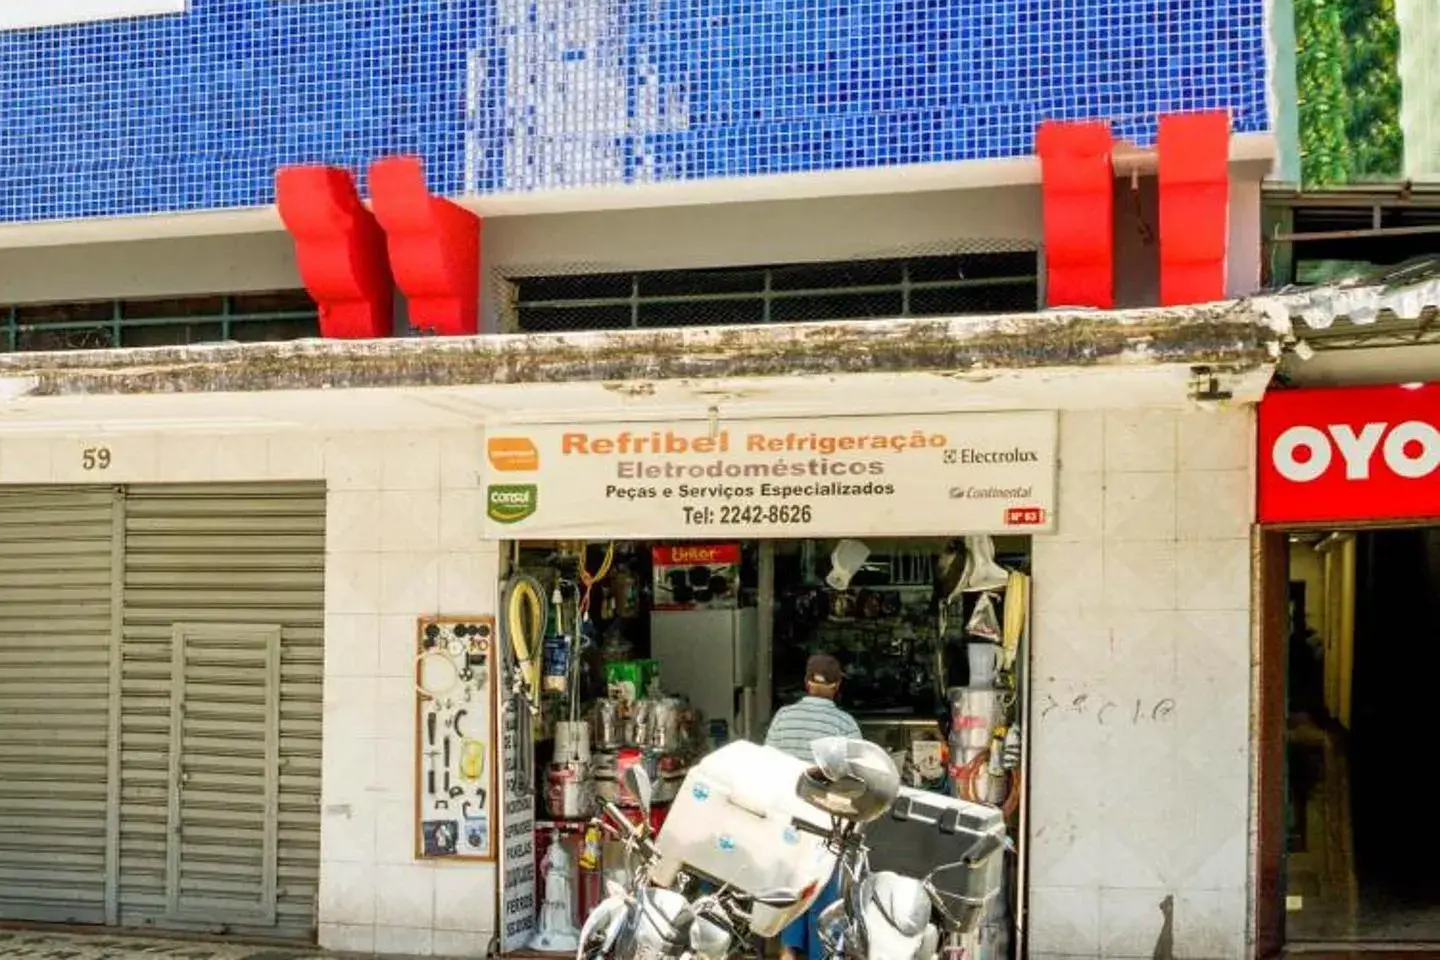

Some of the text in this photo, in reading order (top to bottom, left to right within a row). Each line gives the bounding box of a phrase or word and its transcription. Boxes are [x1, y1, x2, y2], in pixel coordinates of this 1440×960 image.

[562, 432, 728, 455] Refribel
[746, 430, 948, 454] Refrigeração
[1272, 420, 1440, 483] OYO
[83, 448, 111, 470] 59
[961, 448, 1038, 464] Electrolux
[617, 458, 885, 479] Eletrodomésticos
[606, 482, 895, 501] Peças e Serviços Especializados
[966, 485, 1032, 499] Continental
[683, 504, 812, 524] Tel: 2242-8626
